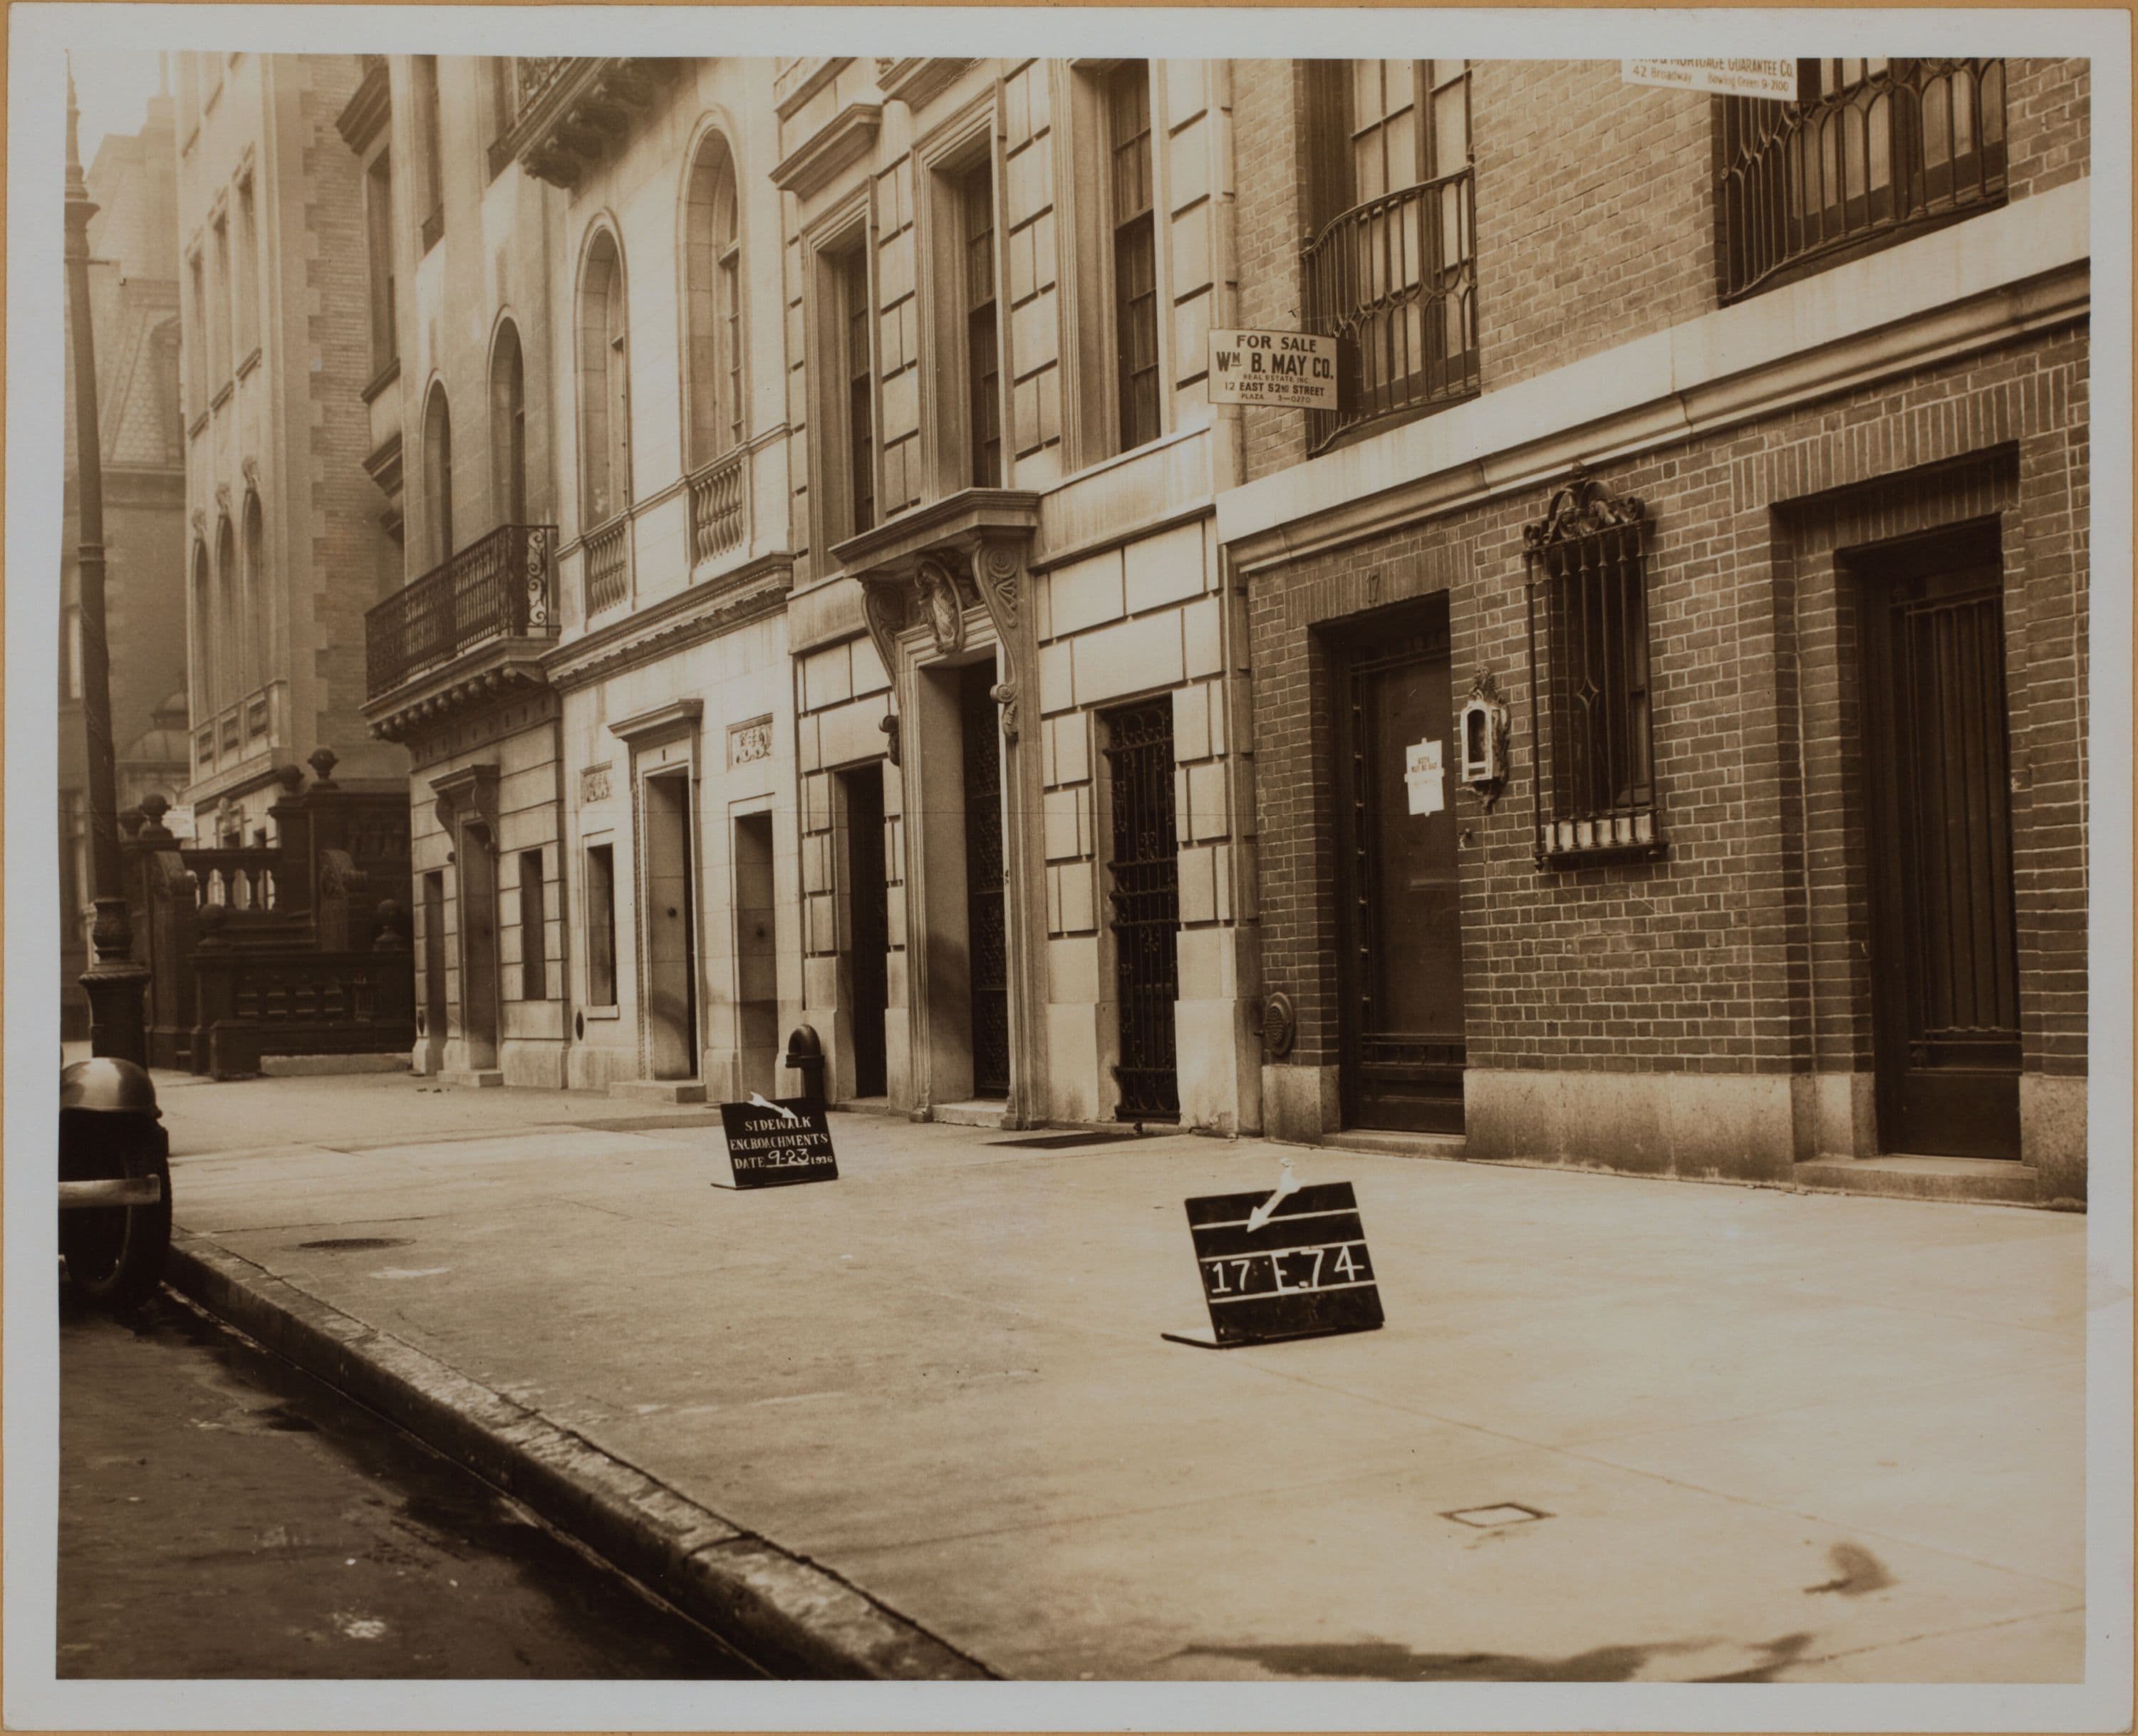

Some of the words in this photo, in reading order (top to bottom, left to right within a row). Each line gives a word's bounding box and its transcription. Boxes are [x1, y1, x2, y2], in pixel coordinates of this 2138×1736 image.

[1728, 58, 1777, 76] GUARANTEE
[1633, 66, 1647, 78] 42
[1651, 67, 1693, 84] Broadway
[1738, 76, 1758, 88] Green
[1236, 335, 1272, 349] FOR
[1281, 337, 1317, 353] SALE
[1251, 353, 1266, 373] B.
[1272, 353, 1307, 375] MAY
[1312, 357, 1334, 380] CO.
[1225, 381, 1235, 391] 12
[1239, 382, 1264, 392] EAST
[1292, 385, 1325, 396] STREET
[744, 1116, 811, 1131] SIDEWALK
[730, 1133, 828, 1151] ENCROACHMENTS
[734, 1156, 765, 1170] DATE
[768, 1148, 809, 1167] 9-23
[1212, 1259, 1251, 1294] 17
